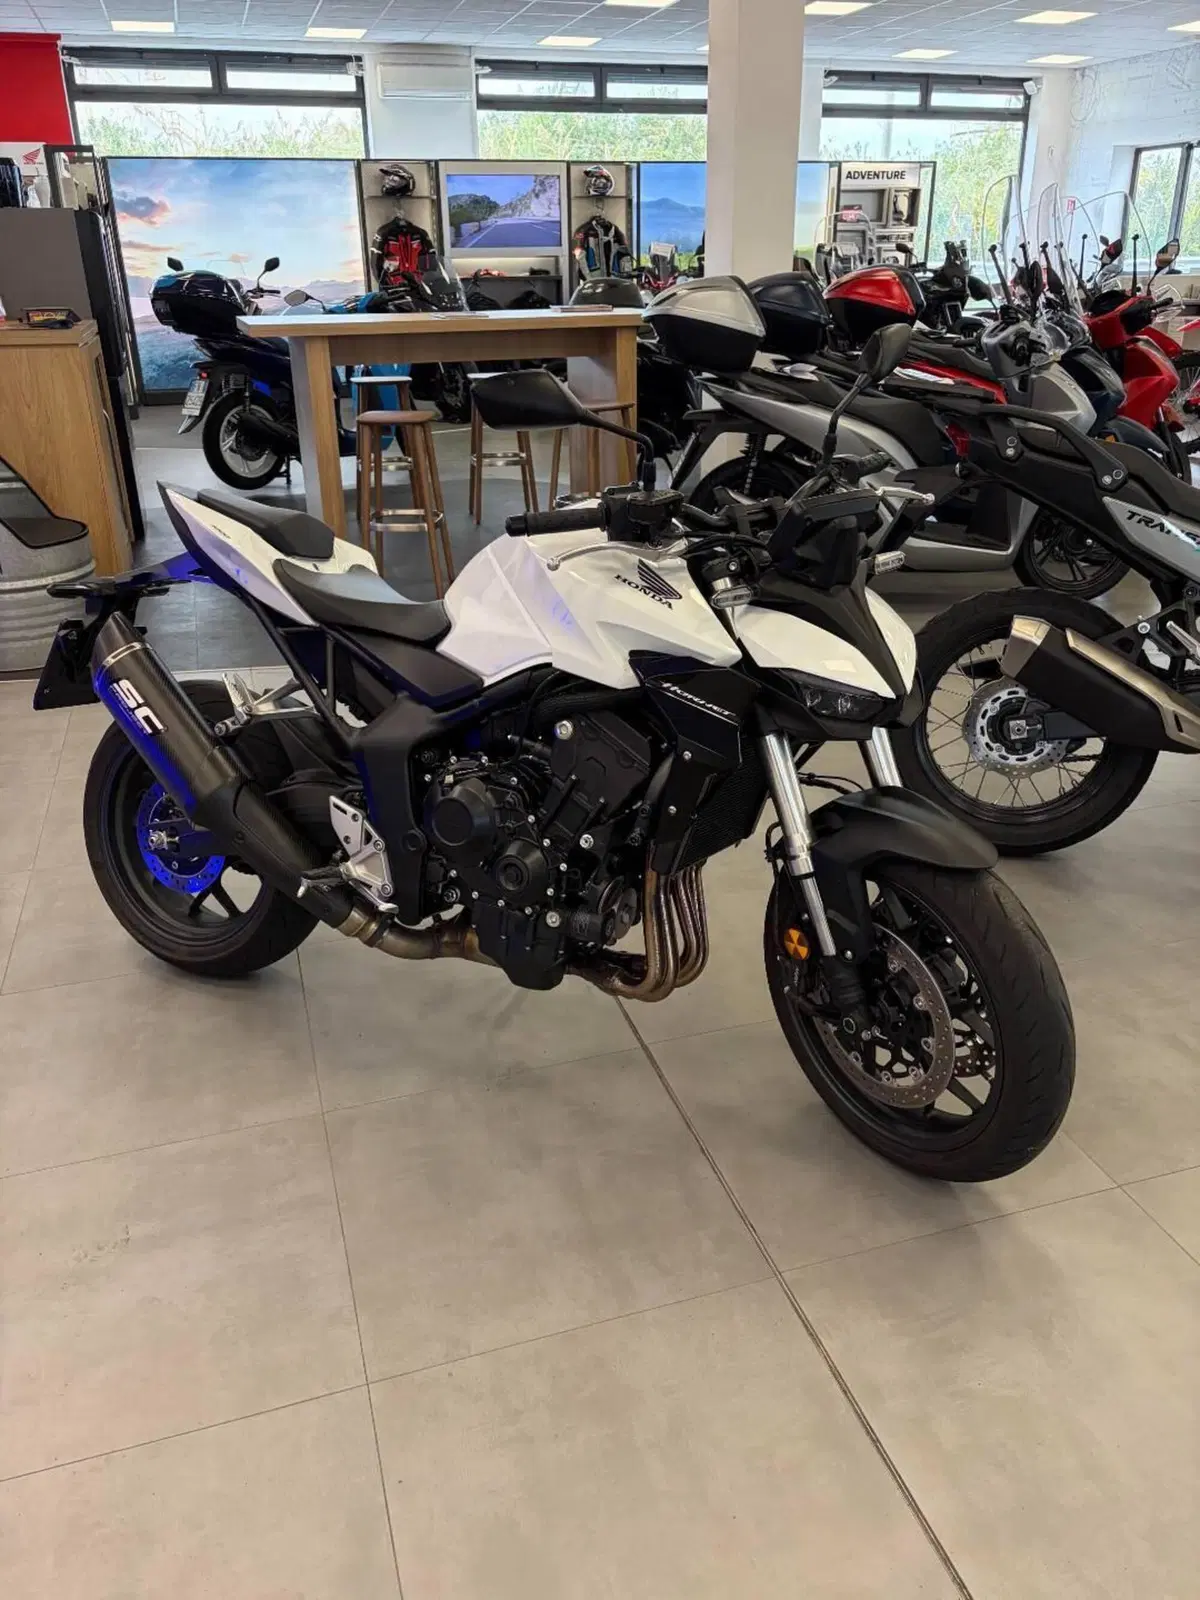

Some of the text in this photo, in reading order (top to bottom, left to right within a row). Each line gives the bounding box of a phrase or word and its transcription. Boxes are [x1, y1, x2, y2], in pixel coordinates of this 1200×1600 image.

[845, 170, 907, 180] ADVENTURE
[614, 574, 674, 610] HONDA
[112, 679, 164, 734] SC
